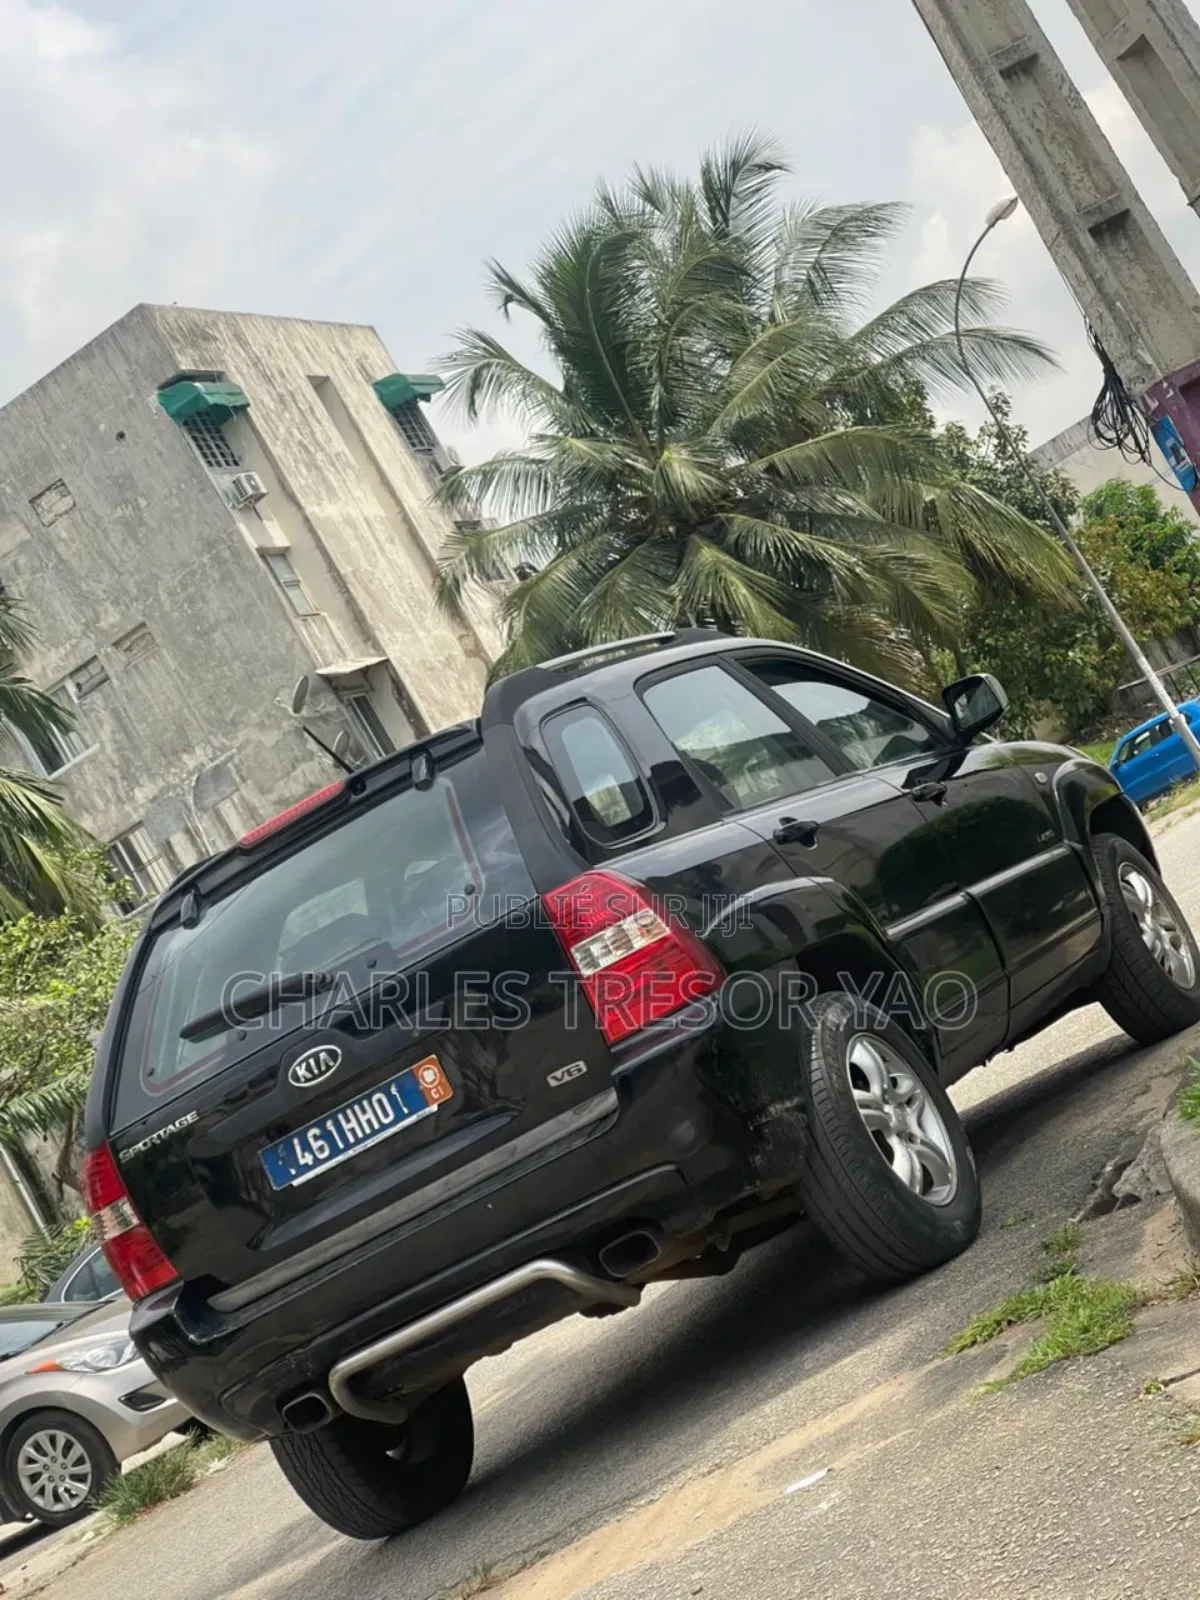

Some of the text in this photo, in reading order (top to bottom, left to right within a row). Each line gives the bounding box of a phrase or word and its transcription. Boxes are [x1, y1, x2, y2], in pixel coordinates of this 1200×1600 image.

[293, 1050, 336, 1083] KIA
[549, 1062, 584, 1083] V6
[118, 1110, 200, 1164] SPORTAGE
